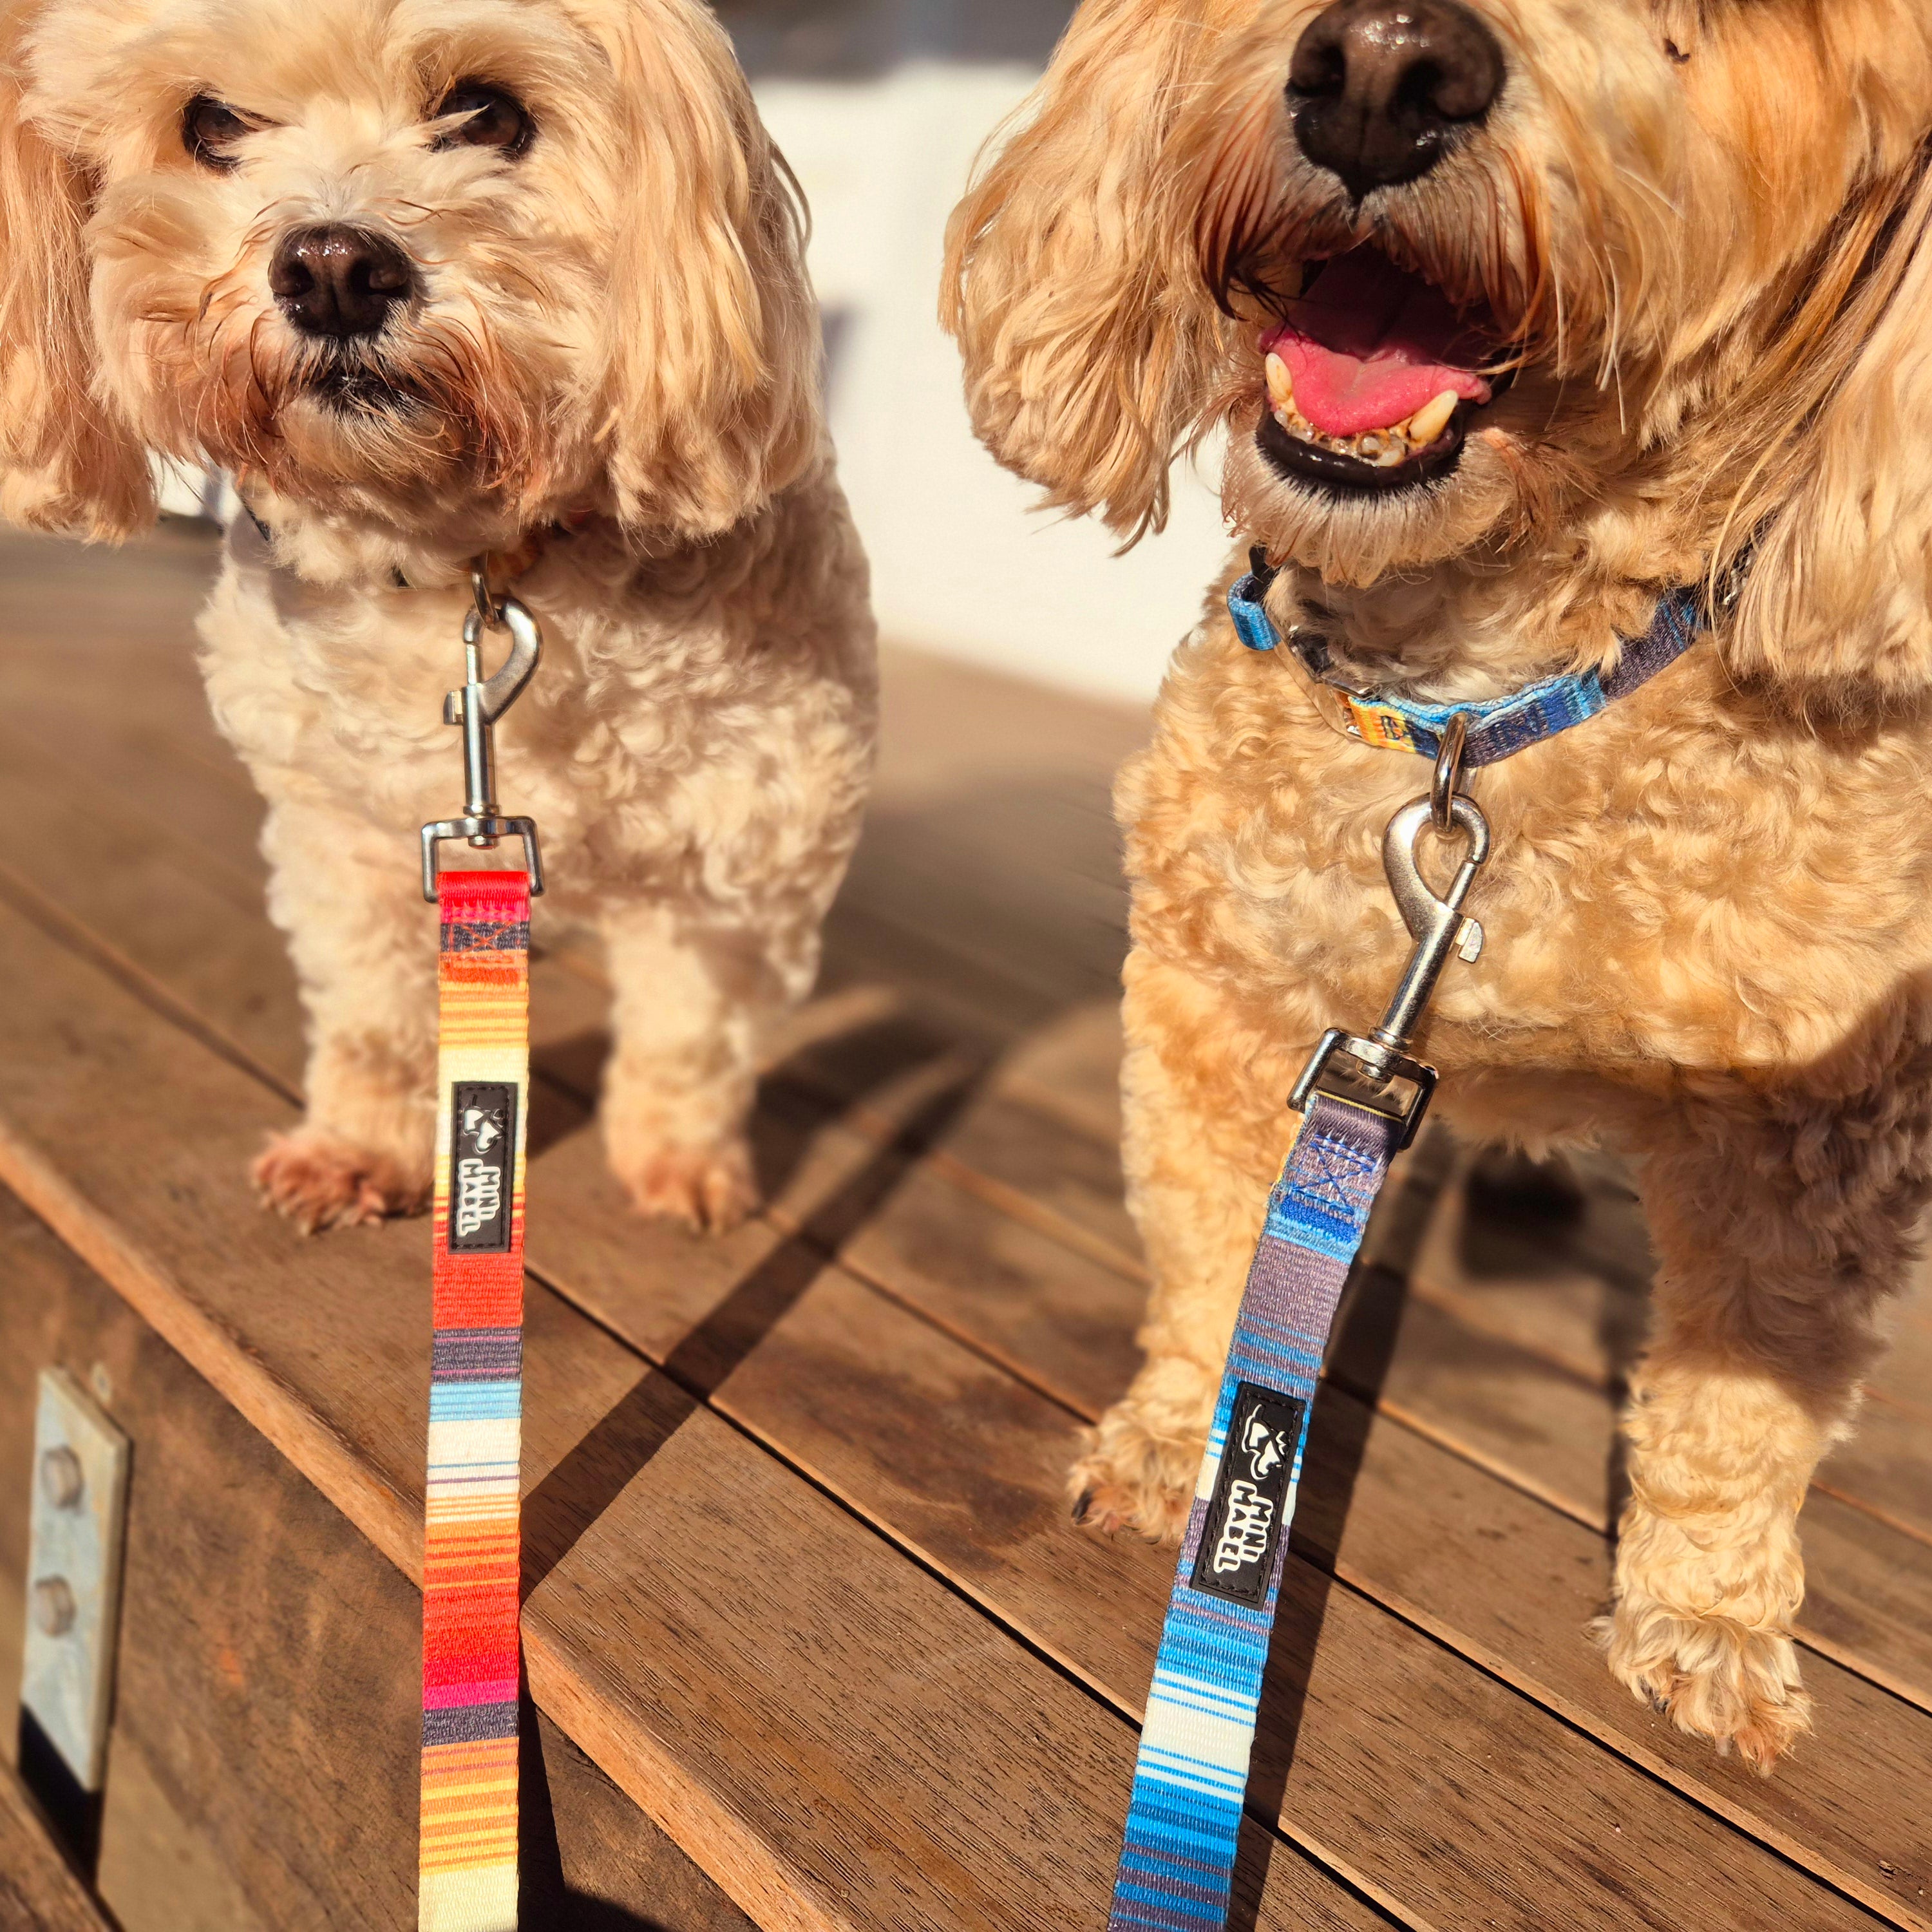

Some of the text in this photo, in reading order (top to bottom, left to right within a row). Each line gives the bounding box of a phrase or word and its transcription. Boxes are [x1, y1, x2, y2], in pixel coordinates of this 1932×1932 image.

[459, 1160, 483, 1235] MABEL
[479, 1168, 500, 1218] MINI
[1215, 1481, 1256, 1572] MABEL
[1240, 1498, 1273, 1562] MINI
